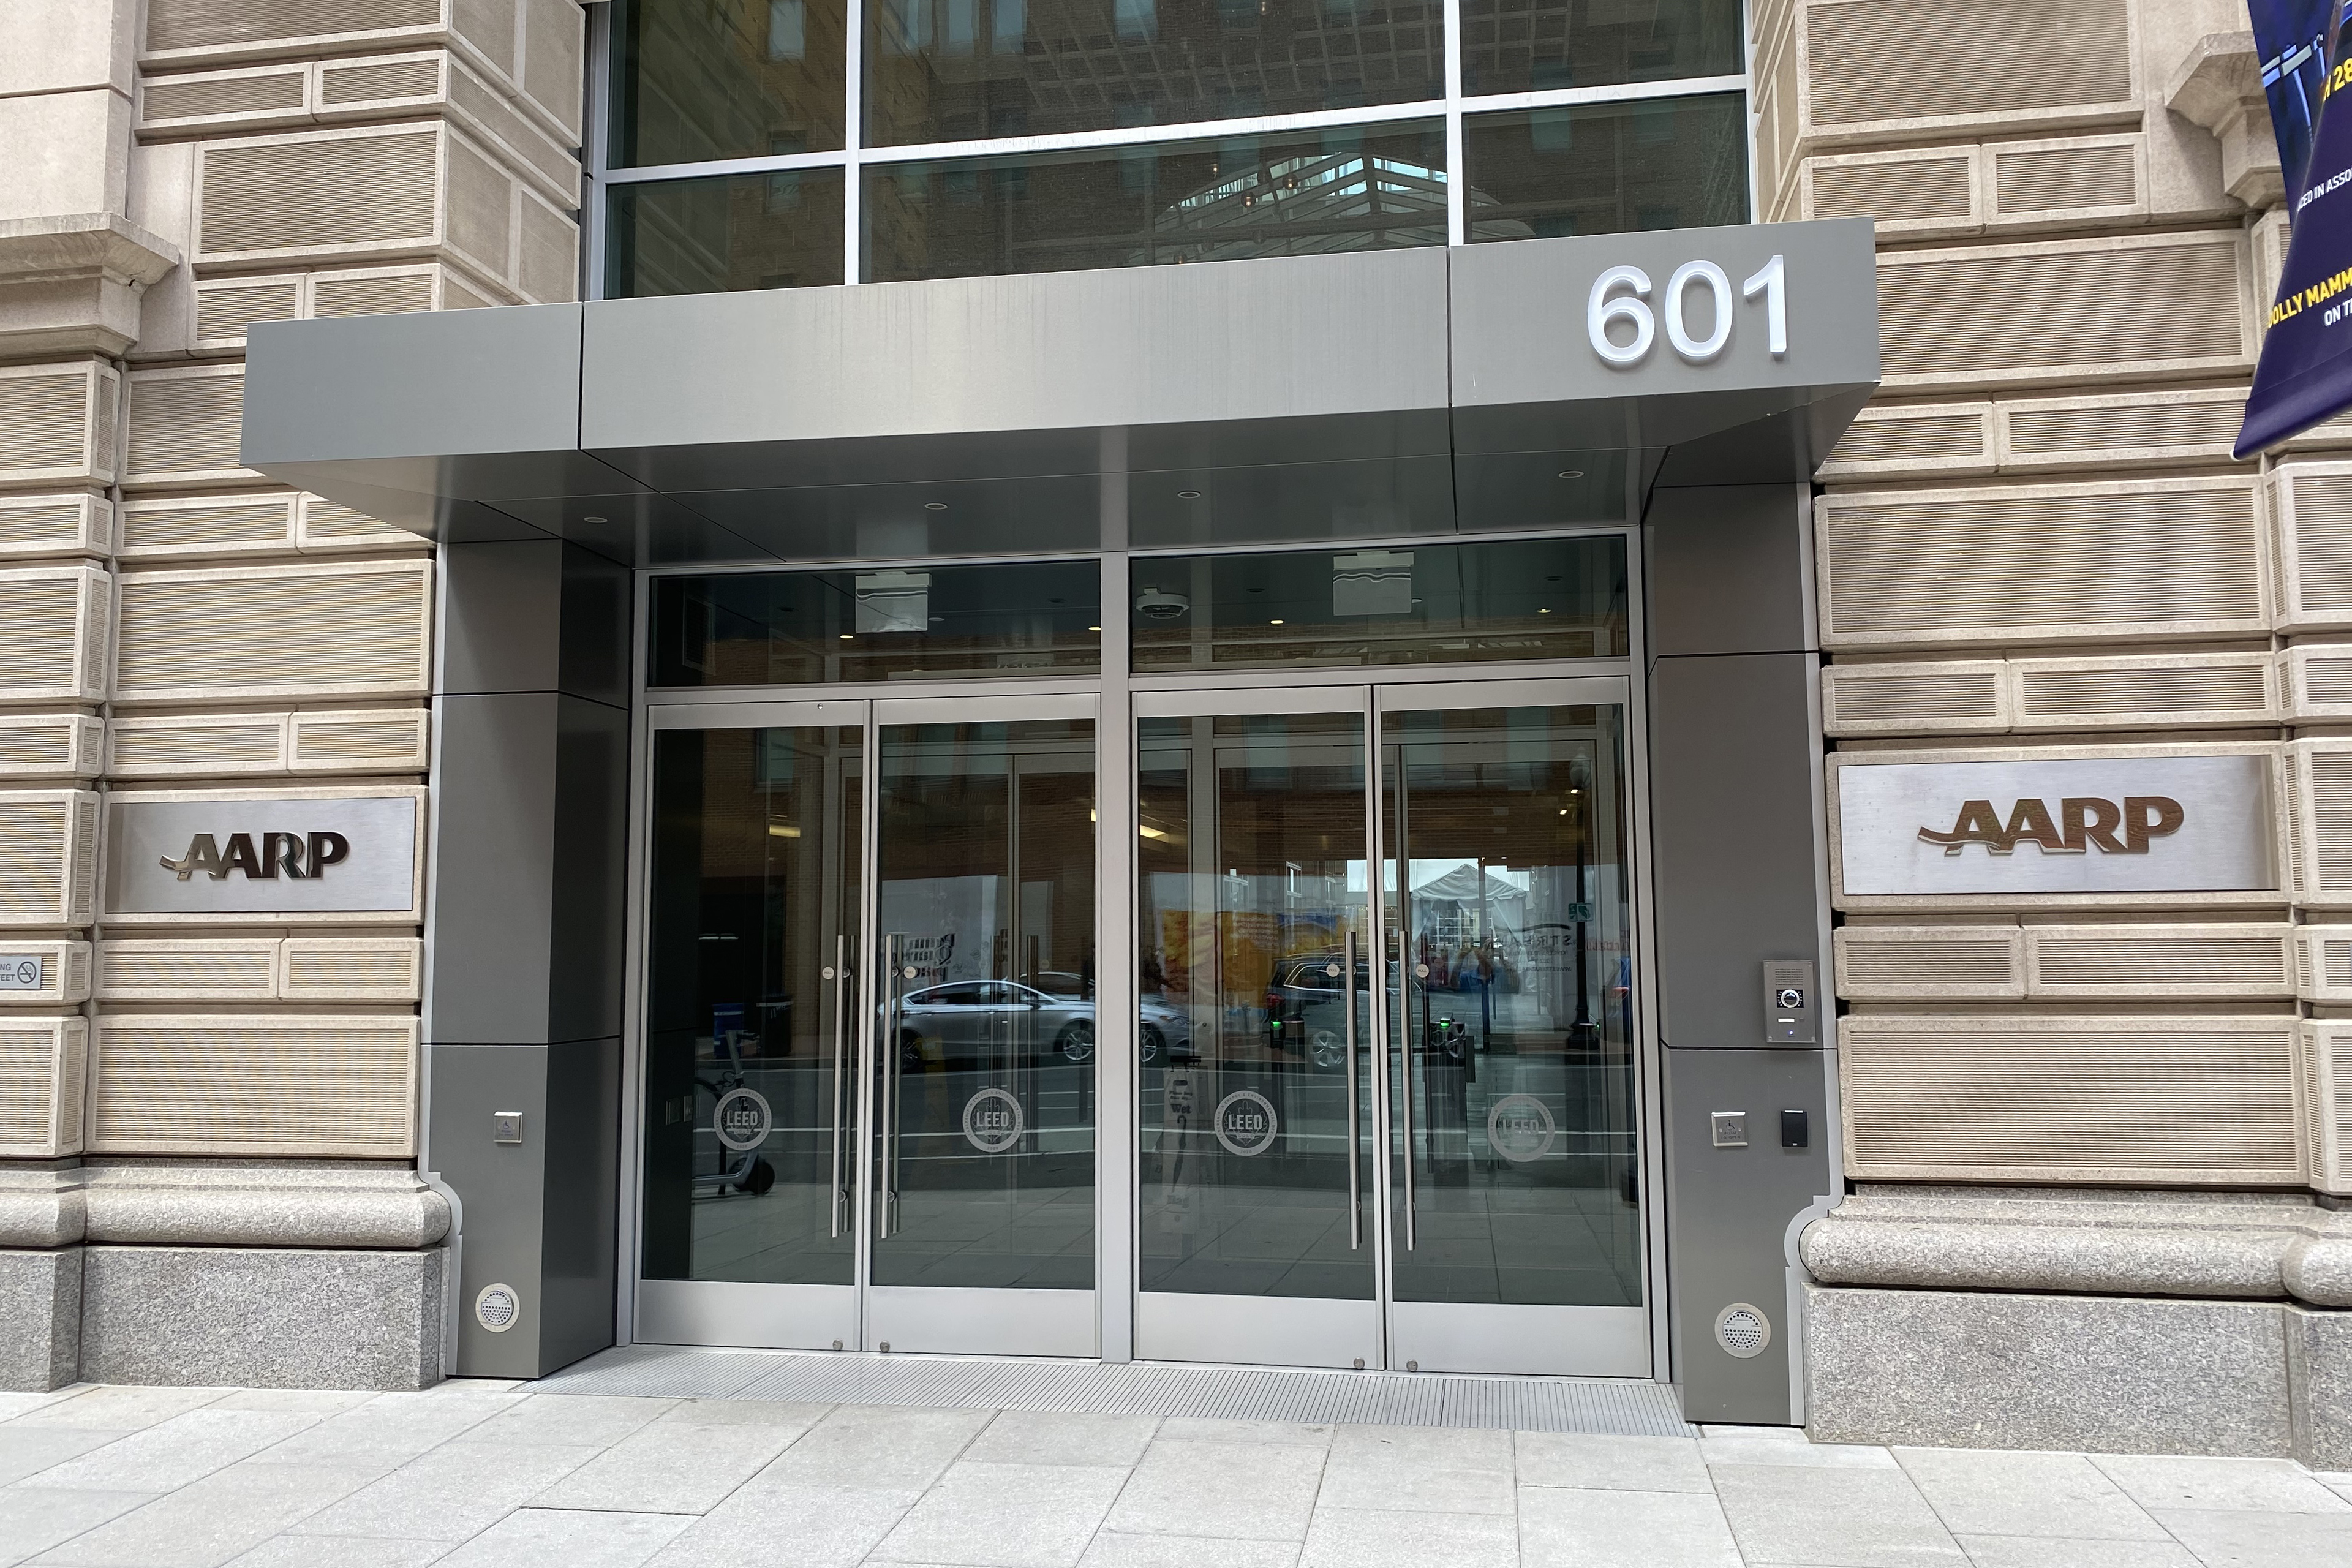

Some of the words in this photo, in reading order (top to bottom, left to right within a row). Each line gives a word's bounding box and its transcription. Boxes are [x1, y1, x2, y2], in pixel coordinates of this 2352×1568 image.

[2314, 183, 2324, 199] IN
[2326, 168, 2352, 193] ASSO
[1588, 254, 1787, 363] 601
[2324, 304, 2341, 326] ON
[1918, 796, 2185, 856] AARP
[159, 832, 350, 880] AARP
[726, 1111, 758, 1126] LEED
[976, 1112, 1009, 1127] LEED
[1228, 1114, 1262, 1130] LEED
